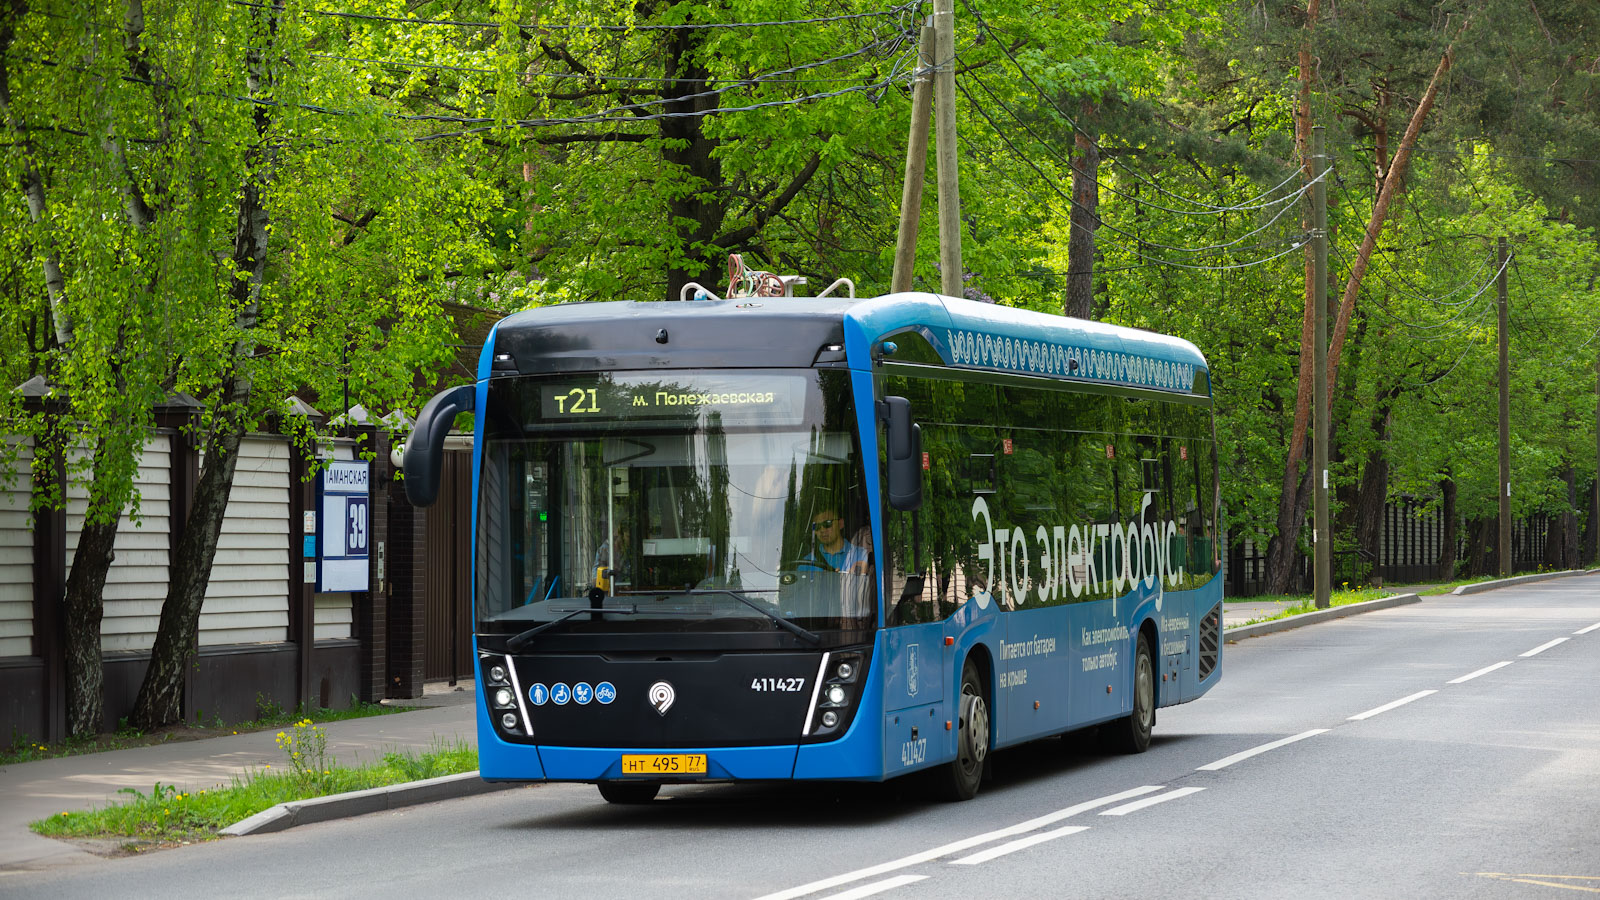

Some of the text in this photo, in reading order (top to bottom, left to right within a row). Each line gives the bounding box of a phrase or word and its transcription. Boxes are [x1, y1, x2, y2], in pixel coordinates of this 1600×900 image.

[632, 391, 774, 407] м. Полежаевская
[349, 503, 367, 549] 39
[972, 491, 1184, 617] Это электробус.
[1000, 633, 1056, 660] Питается от батареи
[1082, 627, 1092, 646] Как
[1081, 647, 1118, 672] только автобус
[751, 677, 806, 692] 411427
[1000, 668, 1028, 692] на крыше
[629, 756, 701, 772] НТ 495 77
[901, 738, 927, 767] 411427
